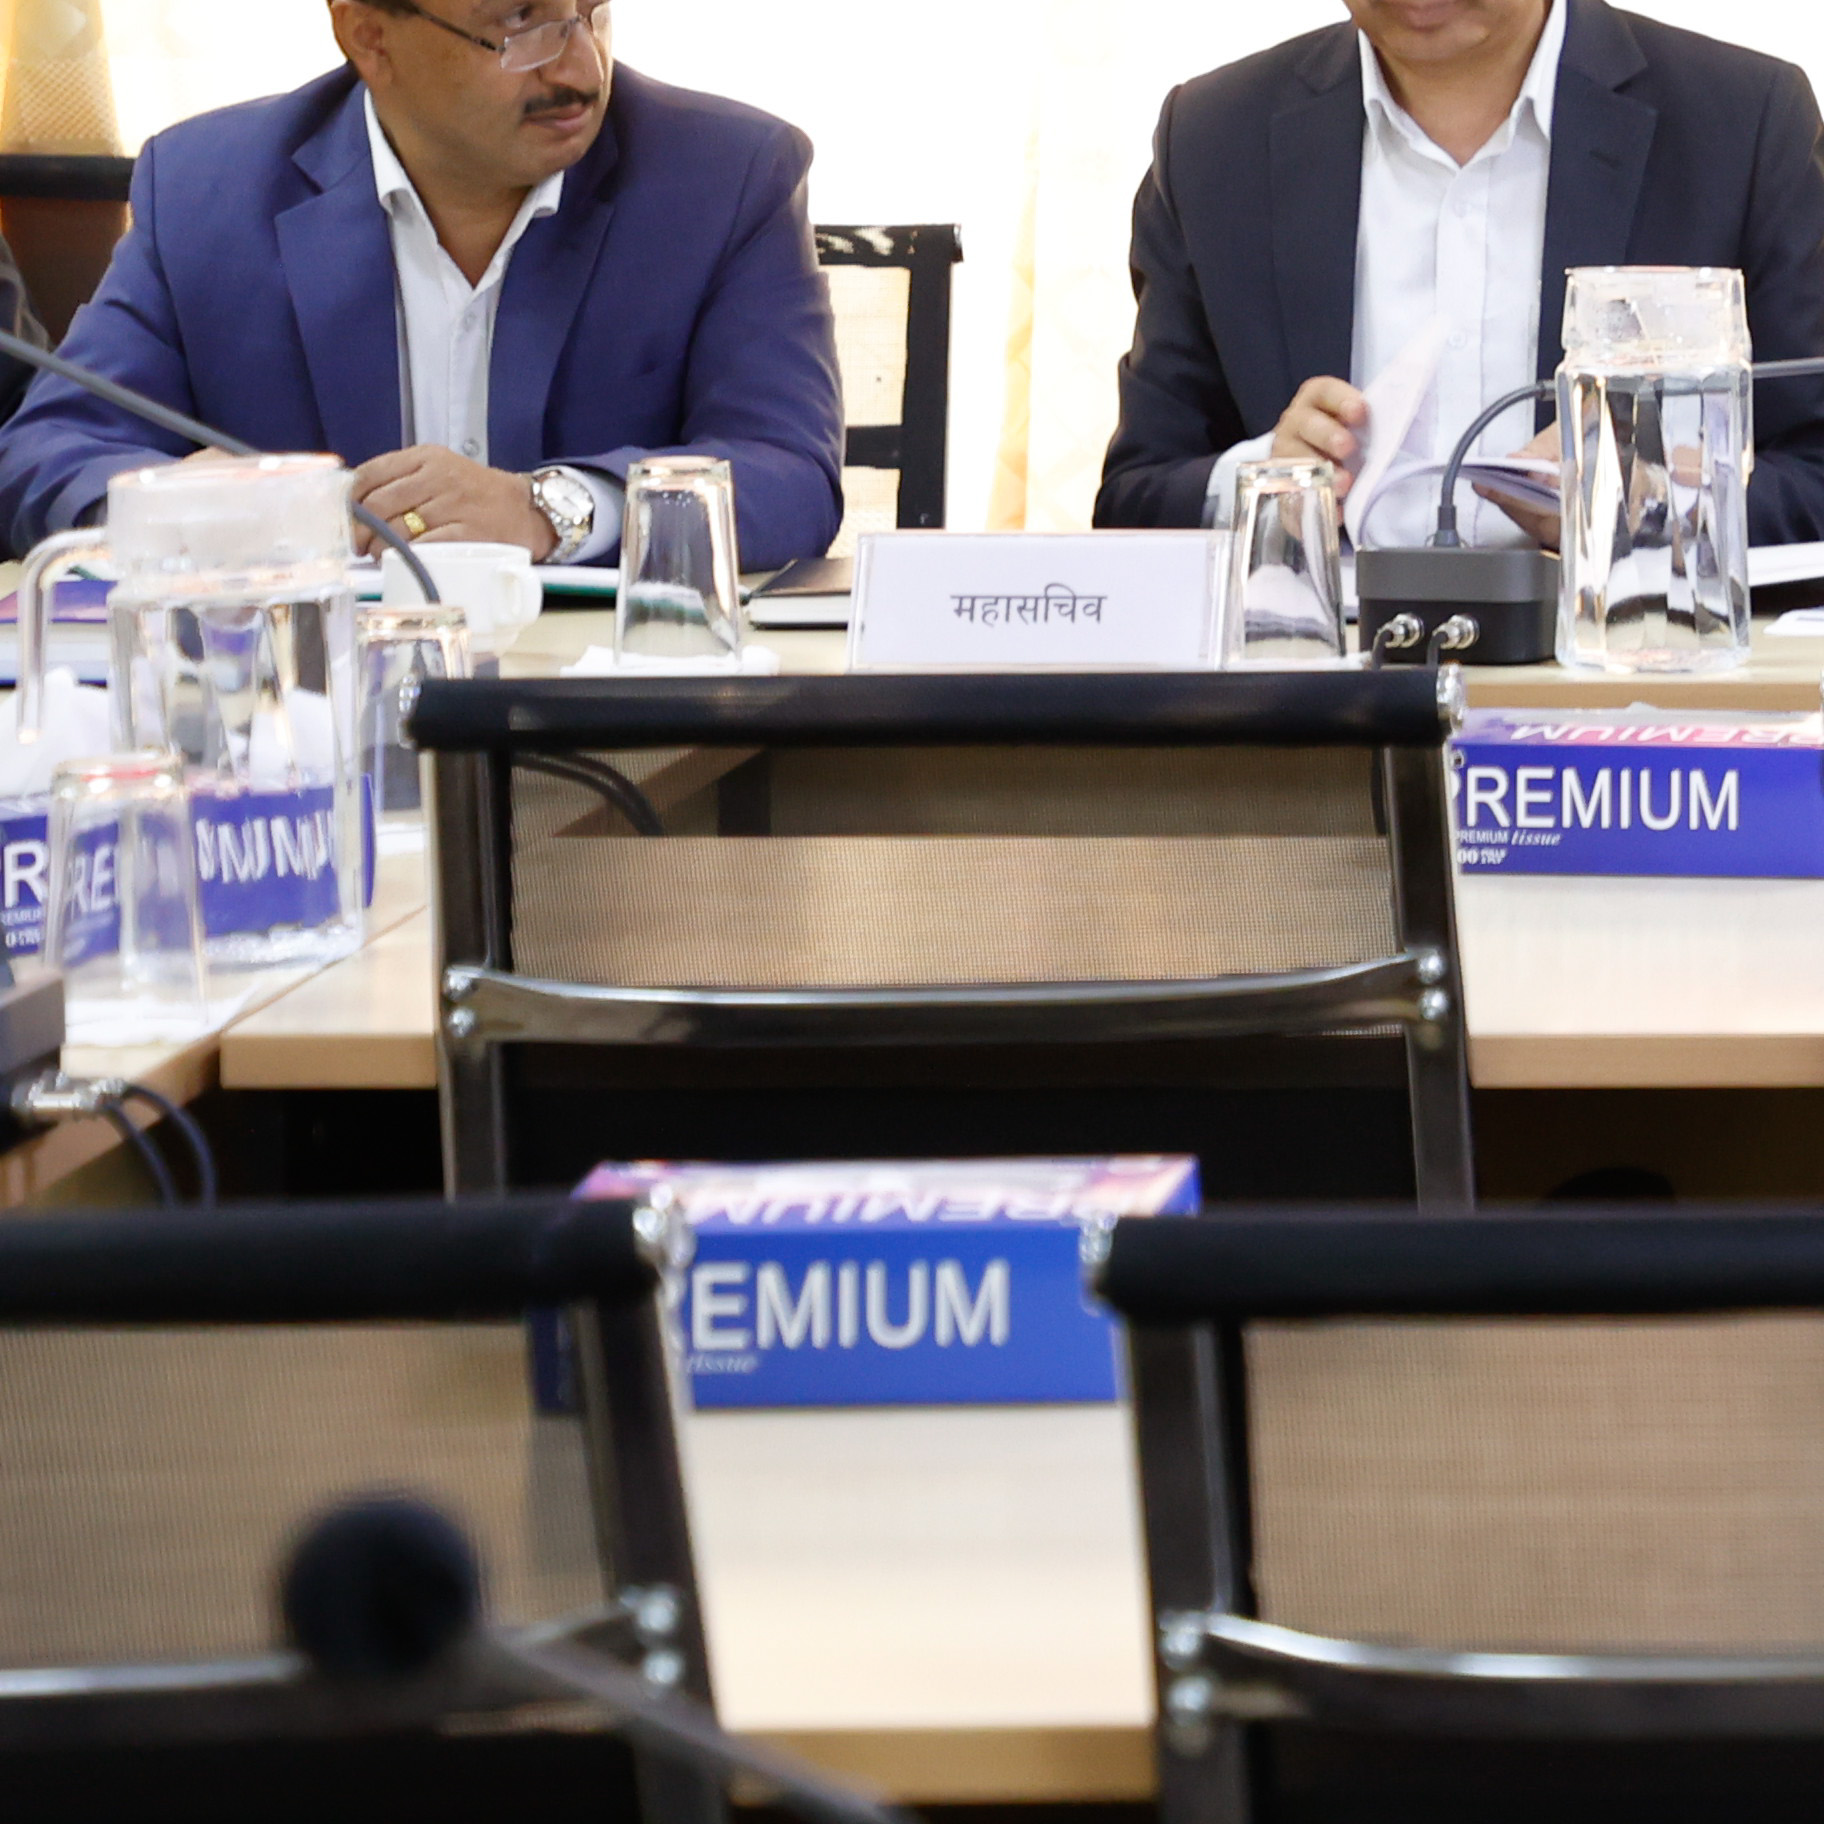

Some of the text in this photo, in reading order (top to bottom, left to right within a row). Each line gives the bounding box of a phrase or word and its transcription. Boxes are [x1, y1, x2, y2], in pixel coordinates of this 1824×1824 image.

[950, 582, 1108, 628] महासचिव
[1511, 829, 1561, 846] tissue
[1456, 847, 1479, 865] 00
[684, 1257, 1010, 1351] EMIUM
